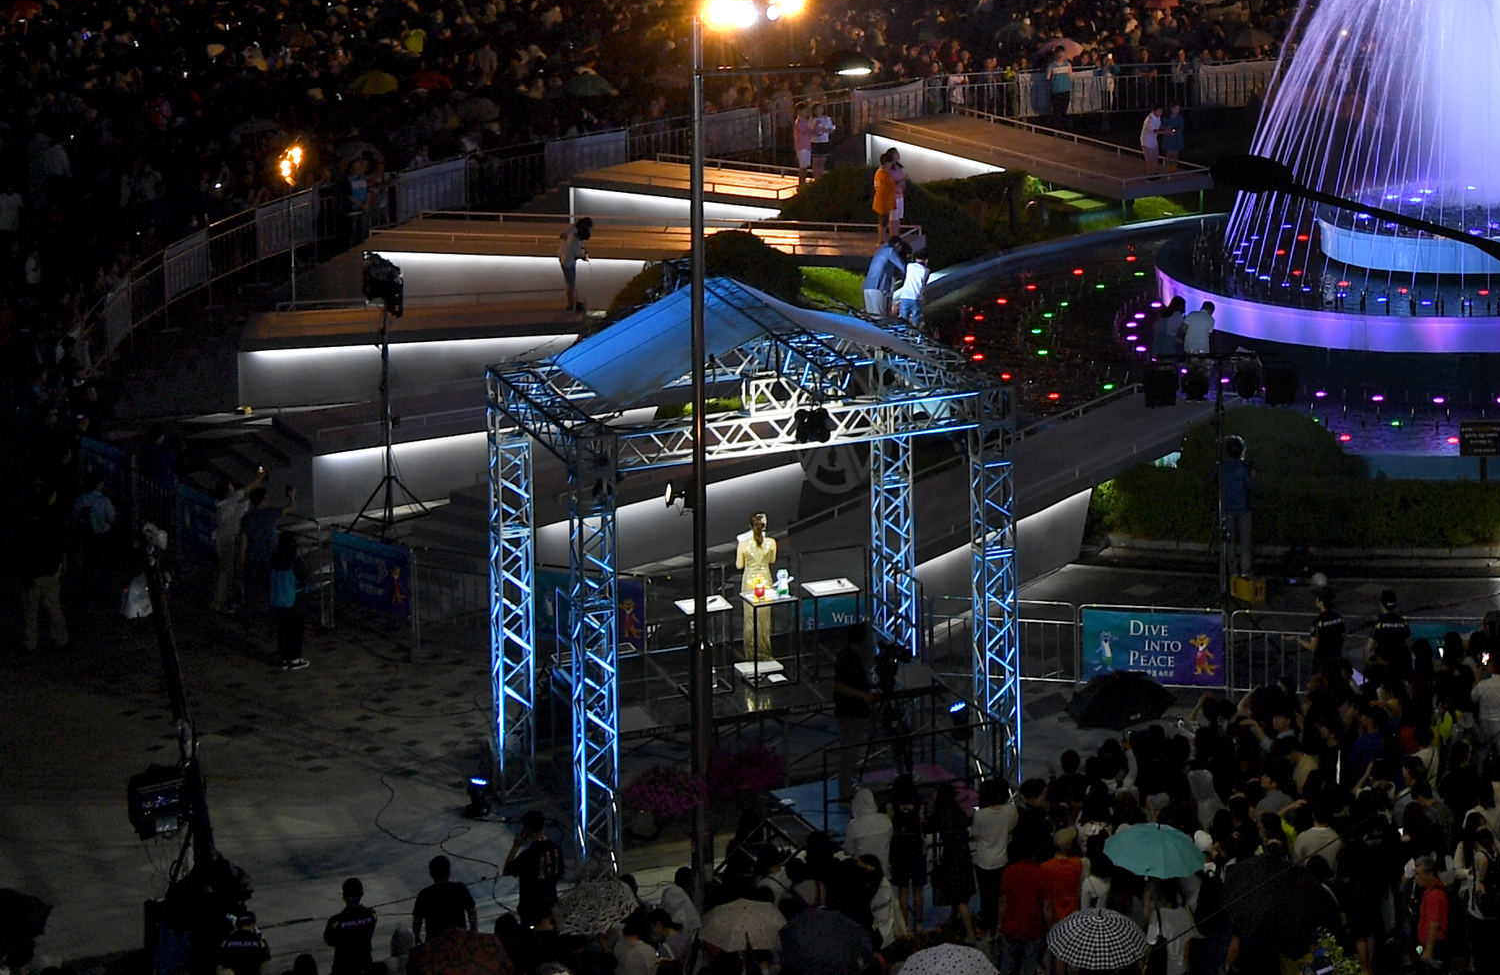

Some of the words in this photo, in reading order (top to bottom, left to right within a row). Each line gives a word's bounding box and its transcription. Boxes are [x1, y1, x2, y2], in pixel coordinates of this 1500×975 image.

[1129, 619, 1168, 636] DIVE
[1144, 639, 1181, 652] INTO
[1129, 650, 1175, 667] PEACE
